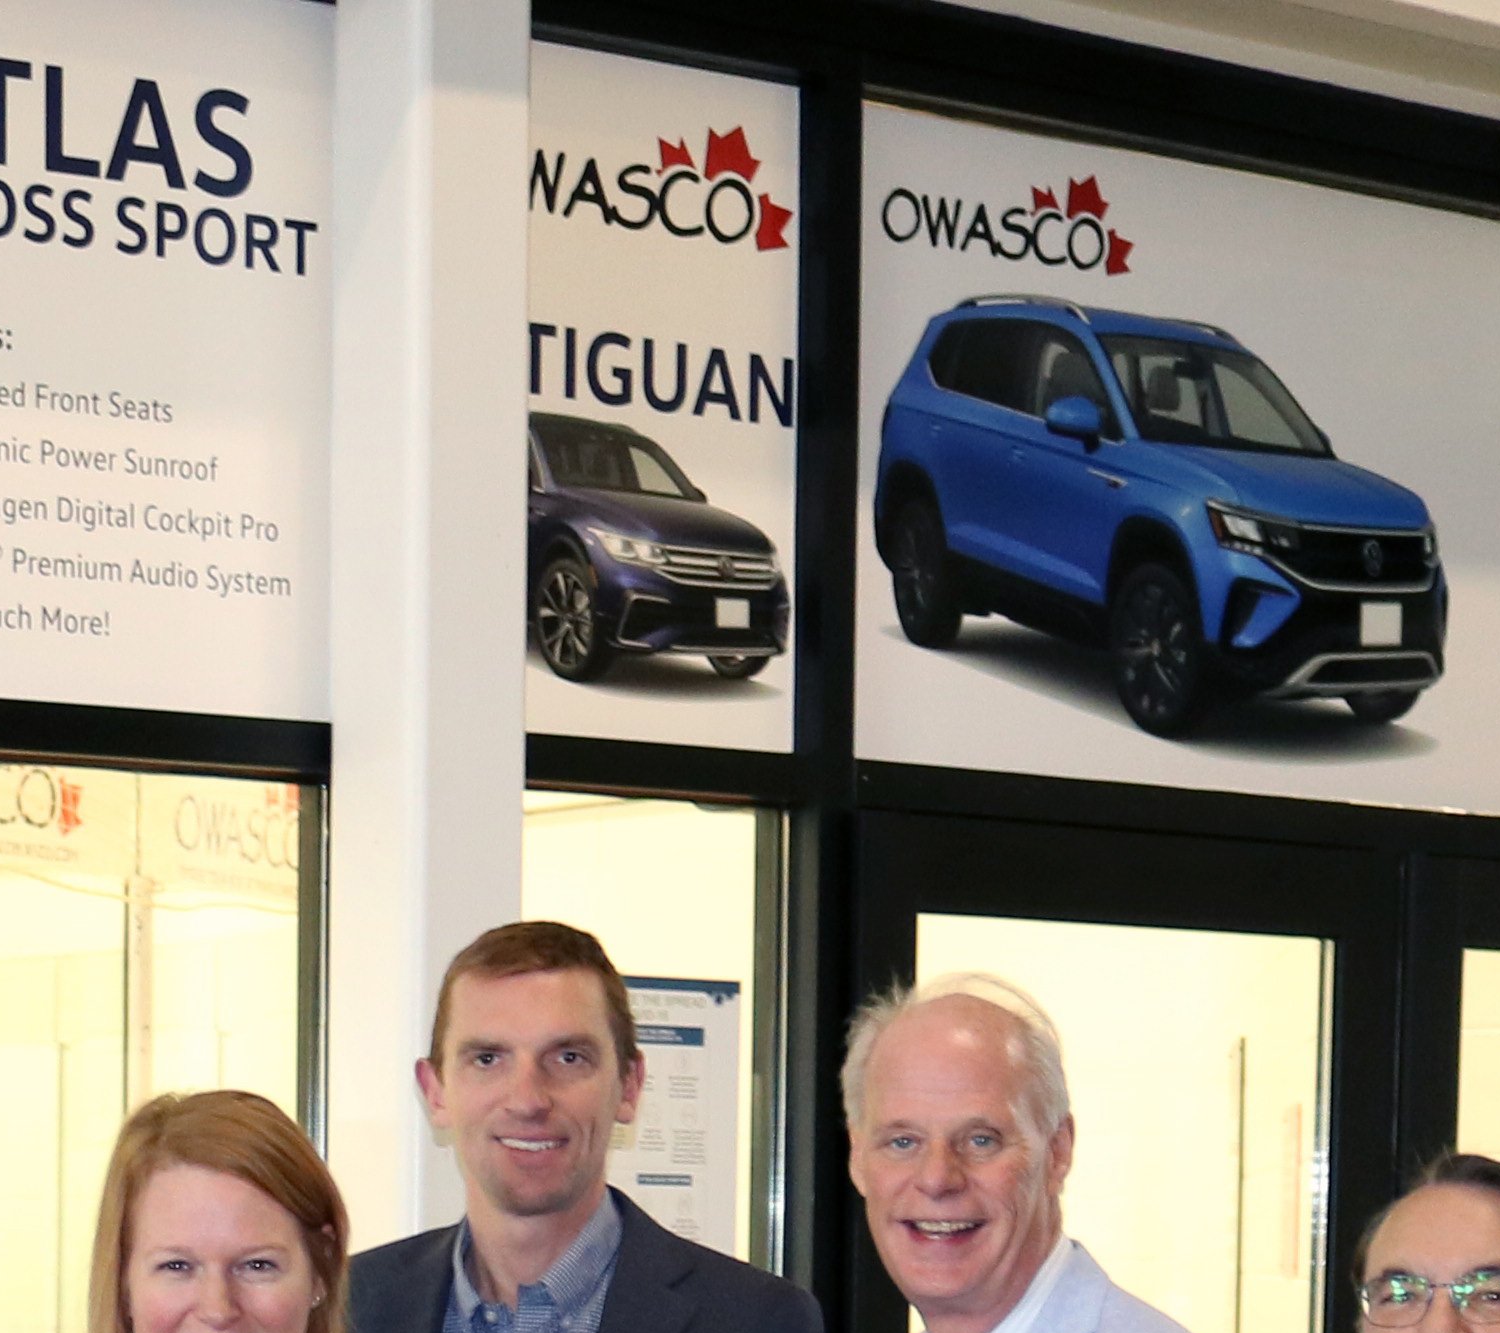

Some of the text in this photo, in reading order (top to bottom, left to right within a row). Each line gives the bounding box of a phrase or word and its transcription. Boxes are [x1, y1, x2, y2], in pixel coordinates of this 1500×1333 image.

[116, 197, 318, 276] SPORT
[882, 188, 1103, 270] OWASCO
[529, 323, 792, 428] TIGUAN
[35, 380, 100, 416] Front
[108, 387, 173, 424] Seats
[41, 440, 116, 471] Power
[125, 448, 217, 481] Sunroof
[57, 497, 134, 532] Digital
[144, 505, 232, 541] Cockpit
[241, 514, 279, 542] Pro
[13, 548, 121, 581] Premium
[130, 559, 198, 588] Audio
[207, 565, 291, 598] System
[42, 606, 109, 635] More!
